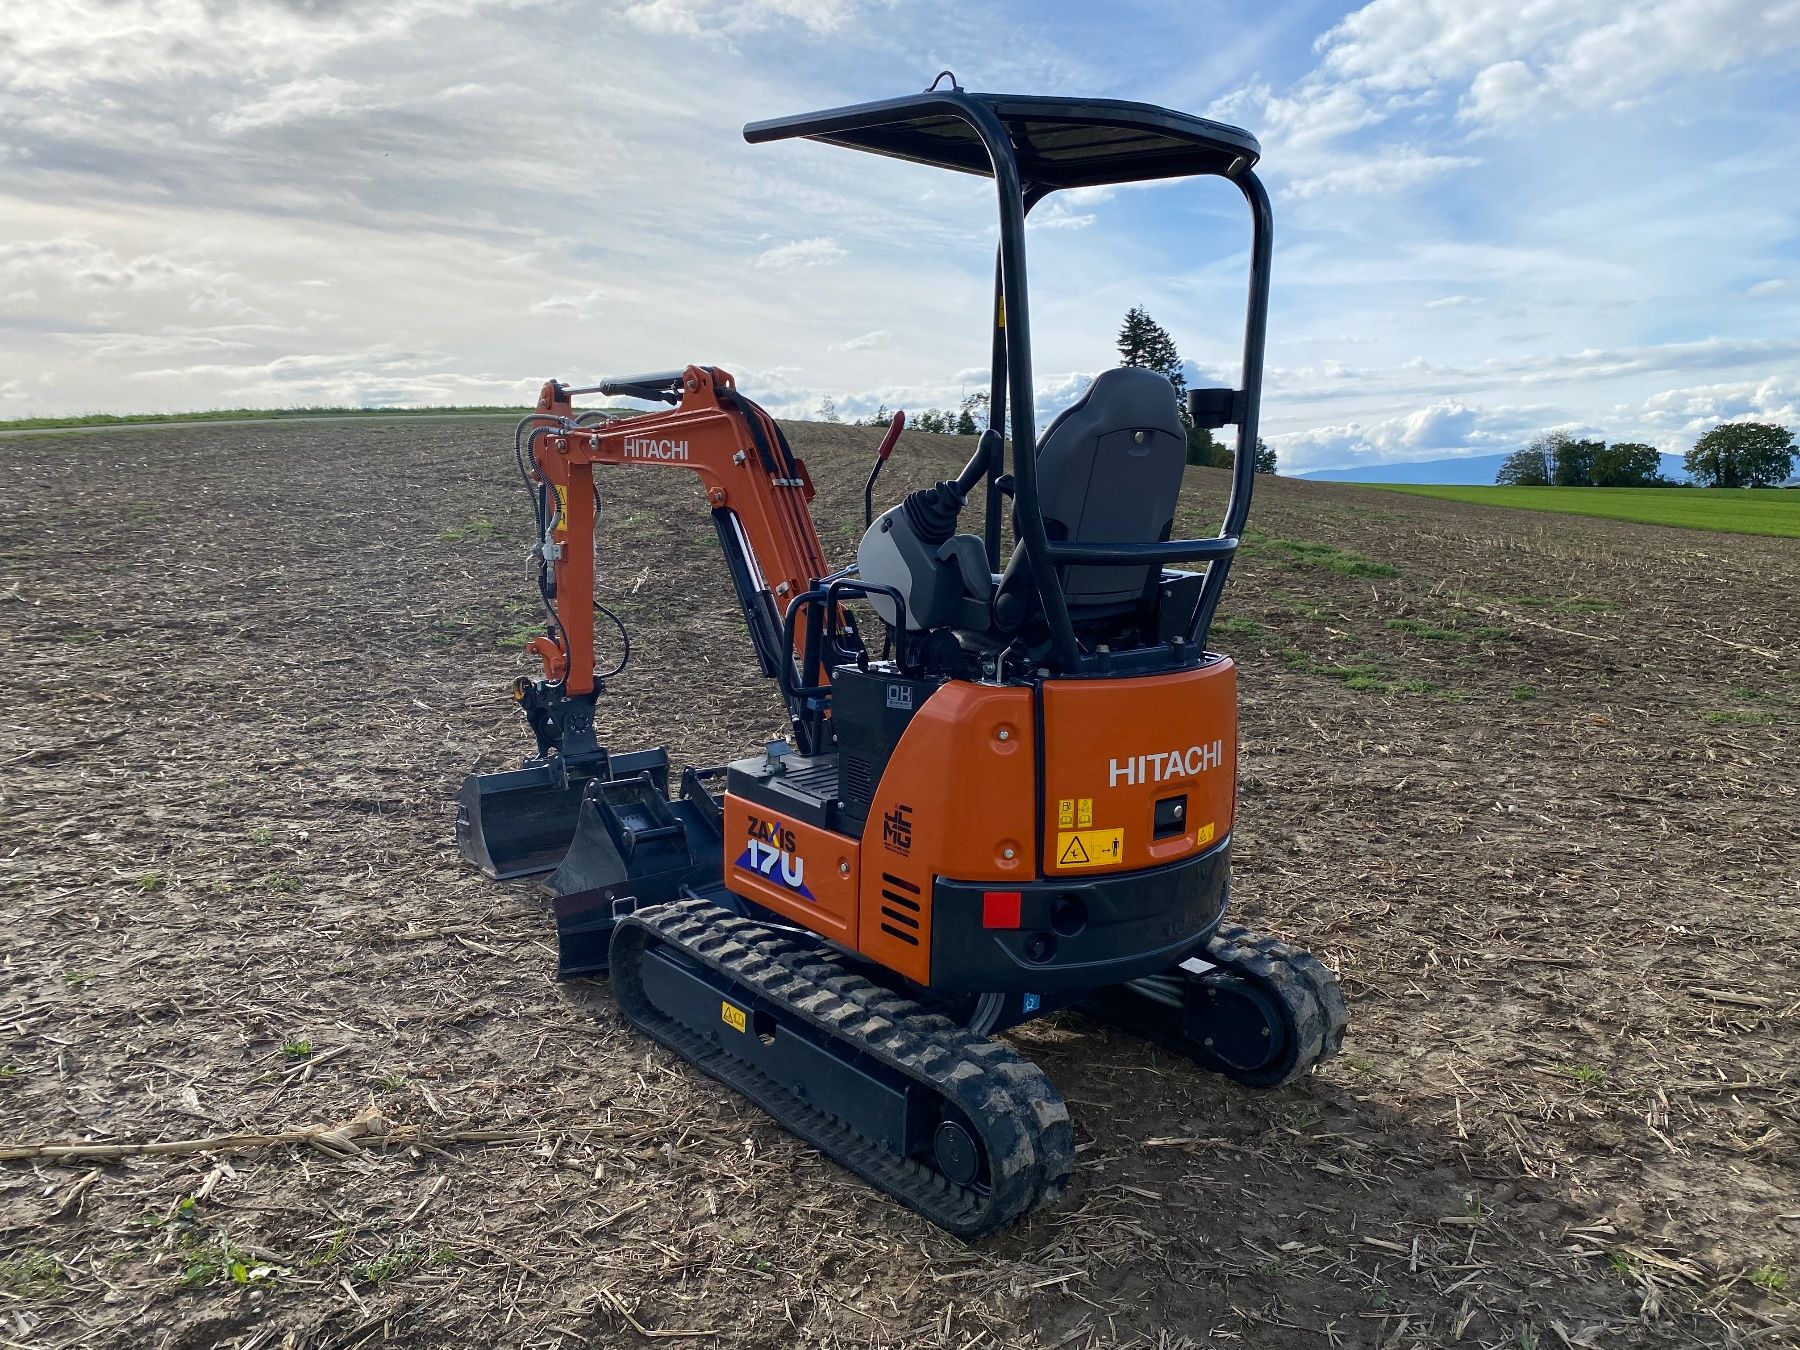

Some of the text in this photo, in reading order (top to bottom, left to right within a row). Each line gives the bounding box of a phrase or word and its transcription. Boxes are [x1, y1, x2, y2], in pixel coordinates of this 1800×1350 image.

[624, 439, 689, 460] HITACHI
[1109, 740, 1222, 787] HITACHI
[747, 815, 796, 853] ZAXIS
[747, 838, 804, 888] 17U
